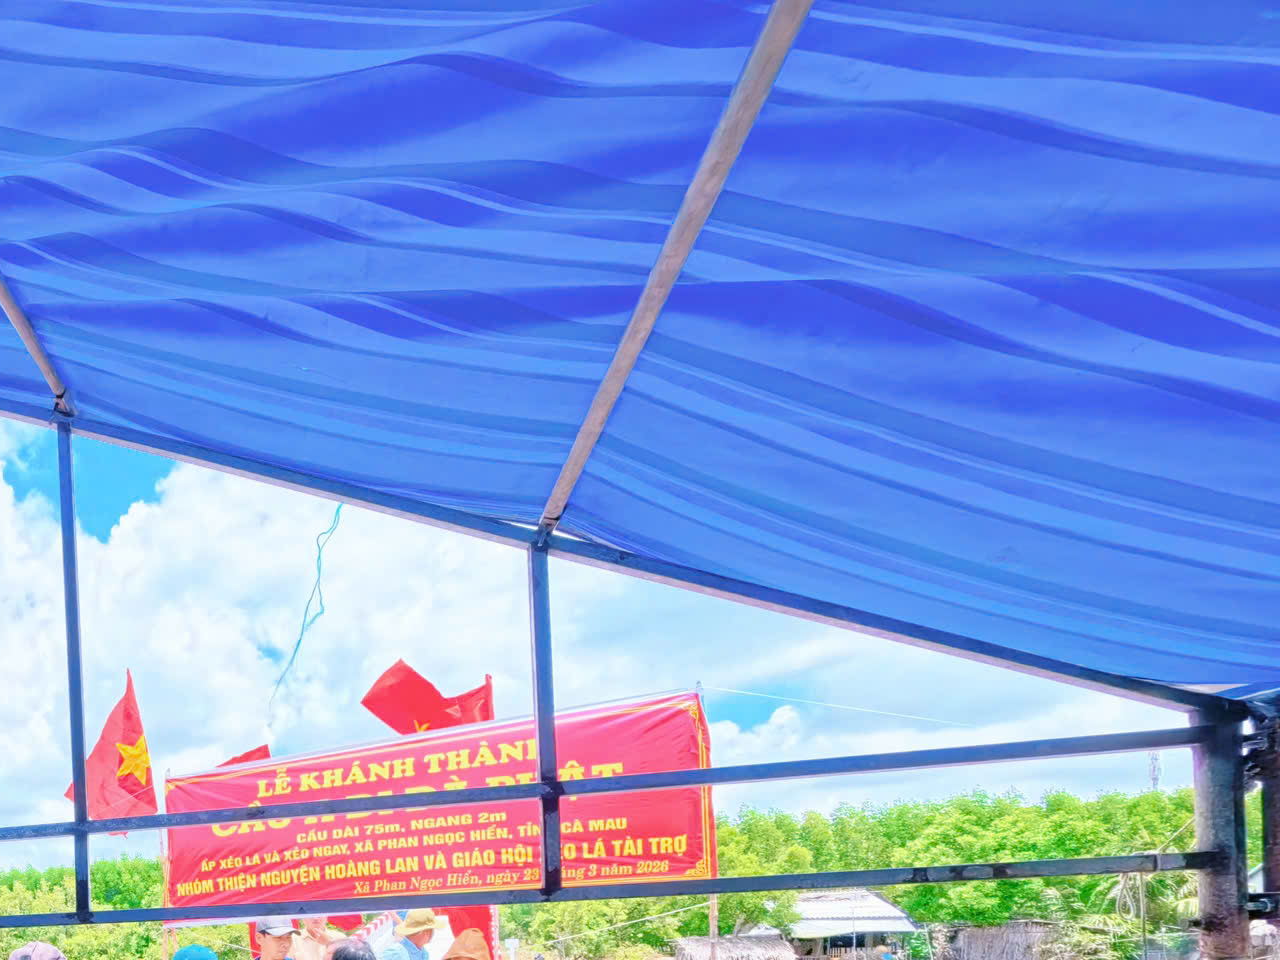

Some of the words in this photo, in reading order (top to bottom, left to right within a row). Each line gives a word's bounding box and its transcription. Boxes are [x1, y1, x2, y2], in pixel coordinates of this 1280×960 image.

[257, 767, 291, 798] LỄ
[300, 757, 415, 791] KHÁNH
[263, 849, 281, 863] VÀ
[377, 836, 419, 850] PHAN
[422, 831, 465, 847] NGỌC
[517, 820, 541, 838] TỈN
[560, 819, 584, 833] CÀ
[588, 817, 628, 831] MAU
[410, 815, 472, 830] NGANG
[477, 812, 507, 825] 2m
[177, 876, 214, 897] NHÓM
[216, 871, 257, 893] THIỆN
[261, 864, 321, 888] NGUYỆN
[324, 858, 381, 879] HOÀNG
[385, 856, 420, 873] LAN
[423, 851, 448, 869] VÀ
[452, 846, 496, 868] GIÁO
[500, 844, 534, 867] HỘI
[582, 837, 608, 859] LÁ
[611, 835, 643, 857] TÀI
[648, 833, 688, 856] TRỢ
[374, 879, 407, 892] Phan
[410, 876, 443, 891] Ngọc
[486, 872, 520, 887] ngày
[588, 864, 598, 876] 3
[600, 863, 633, 876] năm
[636, 859, 670, 874] 2026
